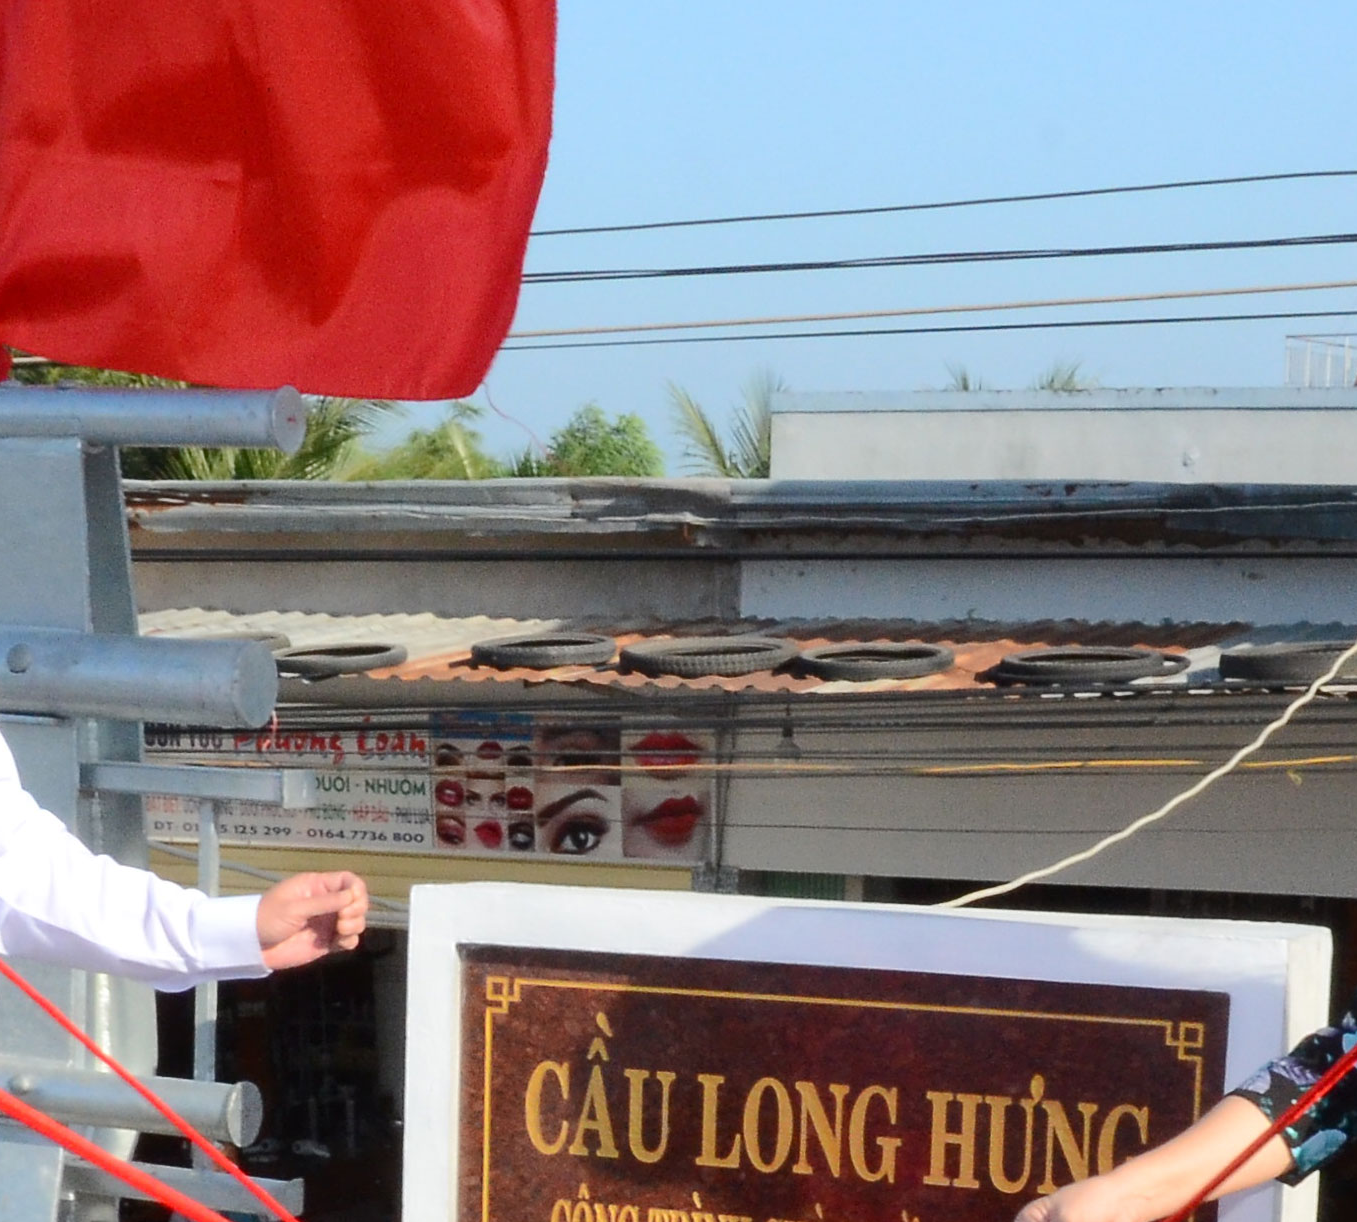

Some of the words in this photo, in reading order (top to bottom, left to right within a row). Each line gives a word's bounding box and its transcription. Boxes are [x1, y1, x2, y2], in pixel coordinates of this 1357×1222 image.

[233, 824, 258, 836] 125
[263, 825, 292, 837] 299
[392, 832, 425, 844] 800
[525, 1011, 677, 1164] CẦU
[695, 1073, 903, 1184] LONG
